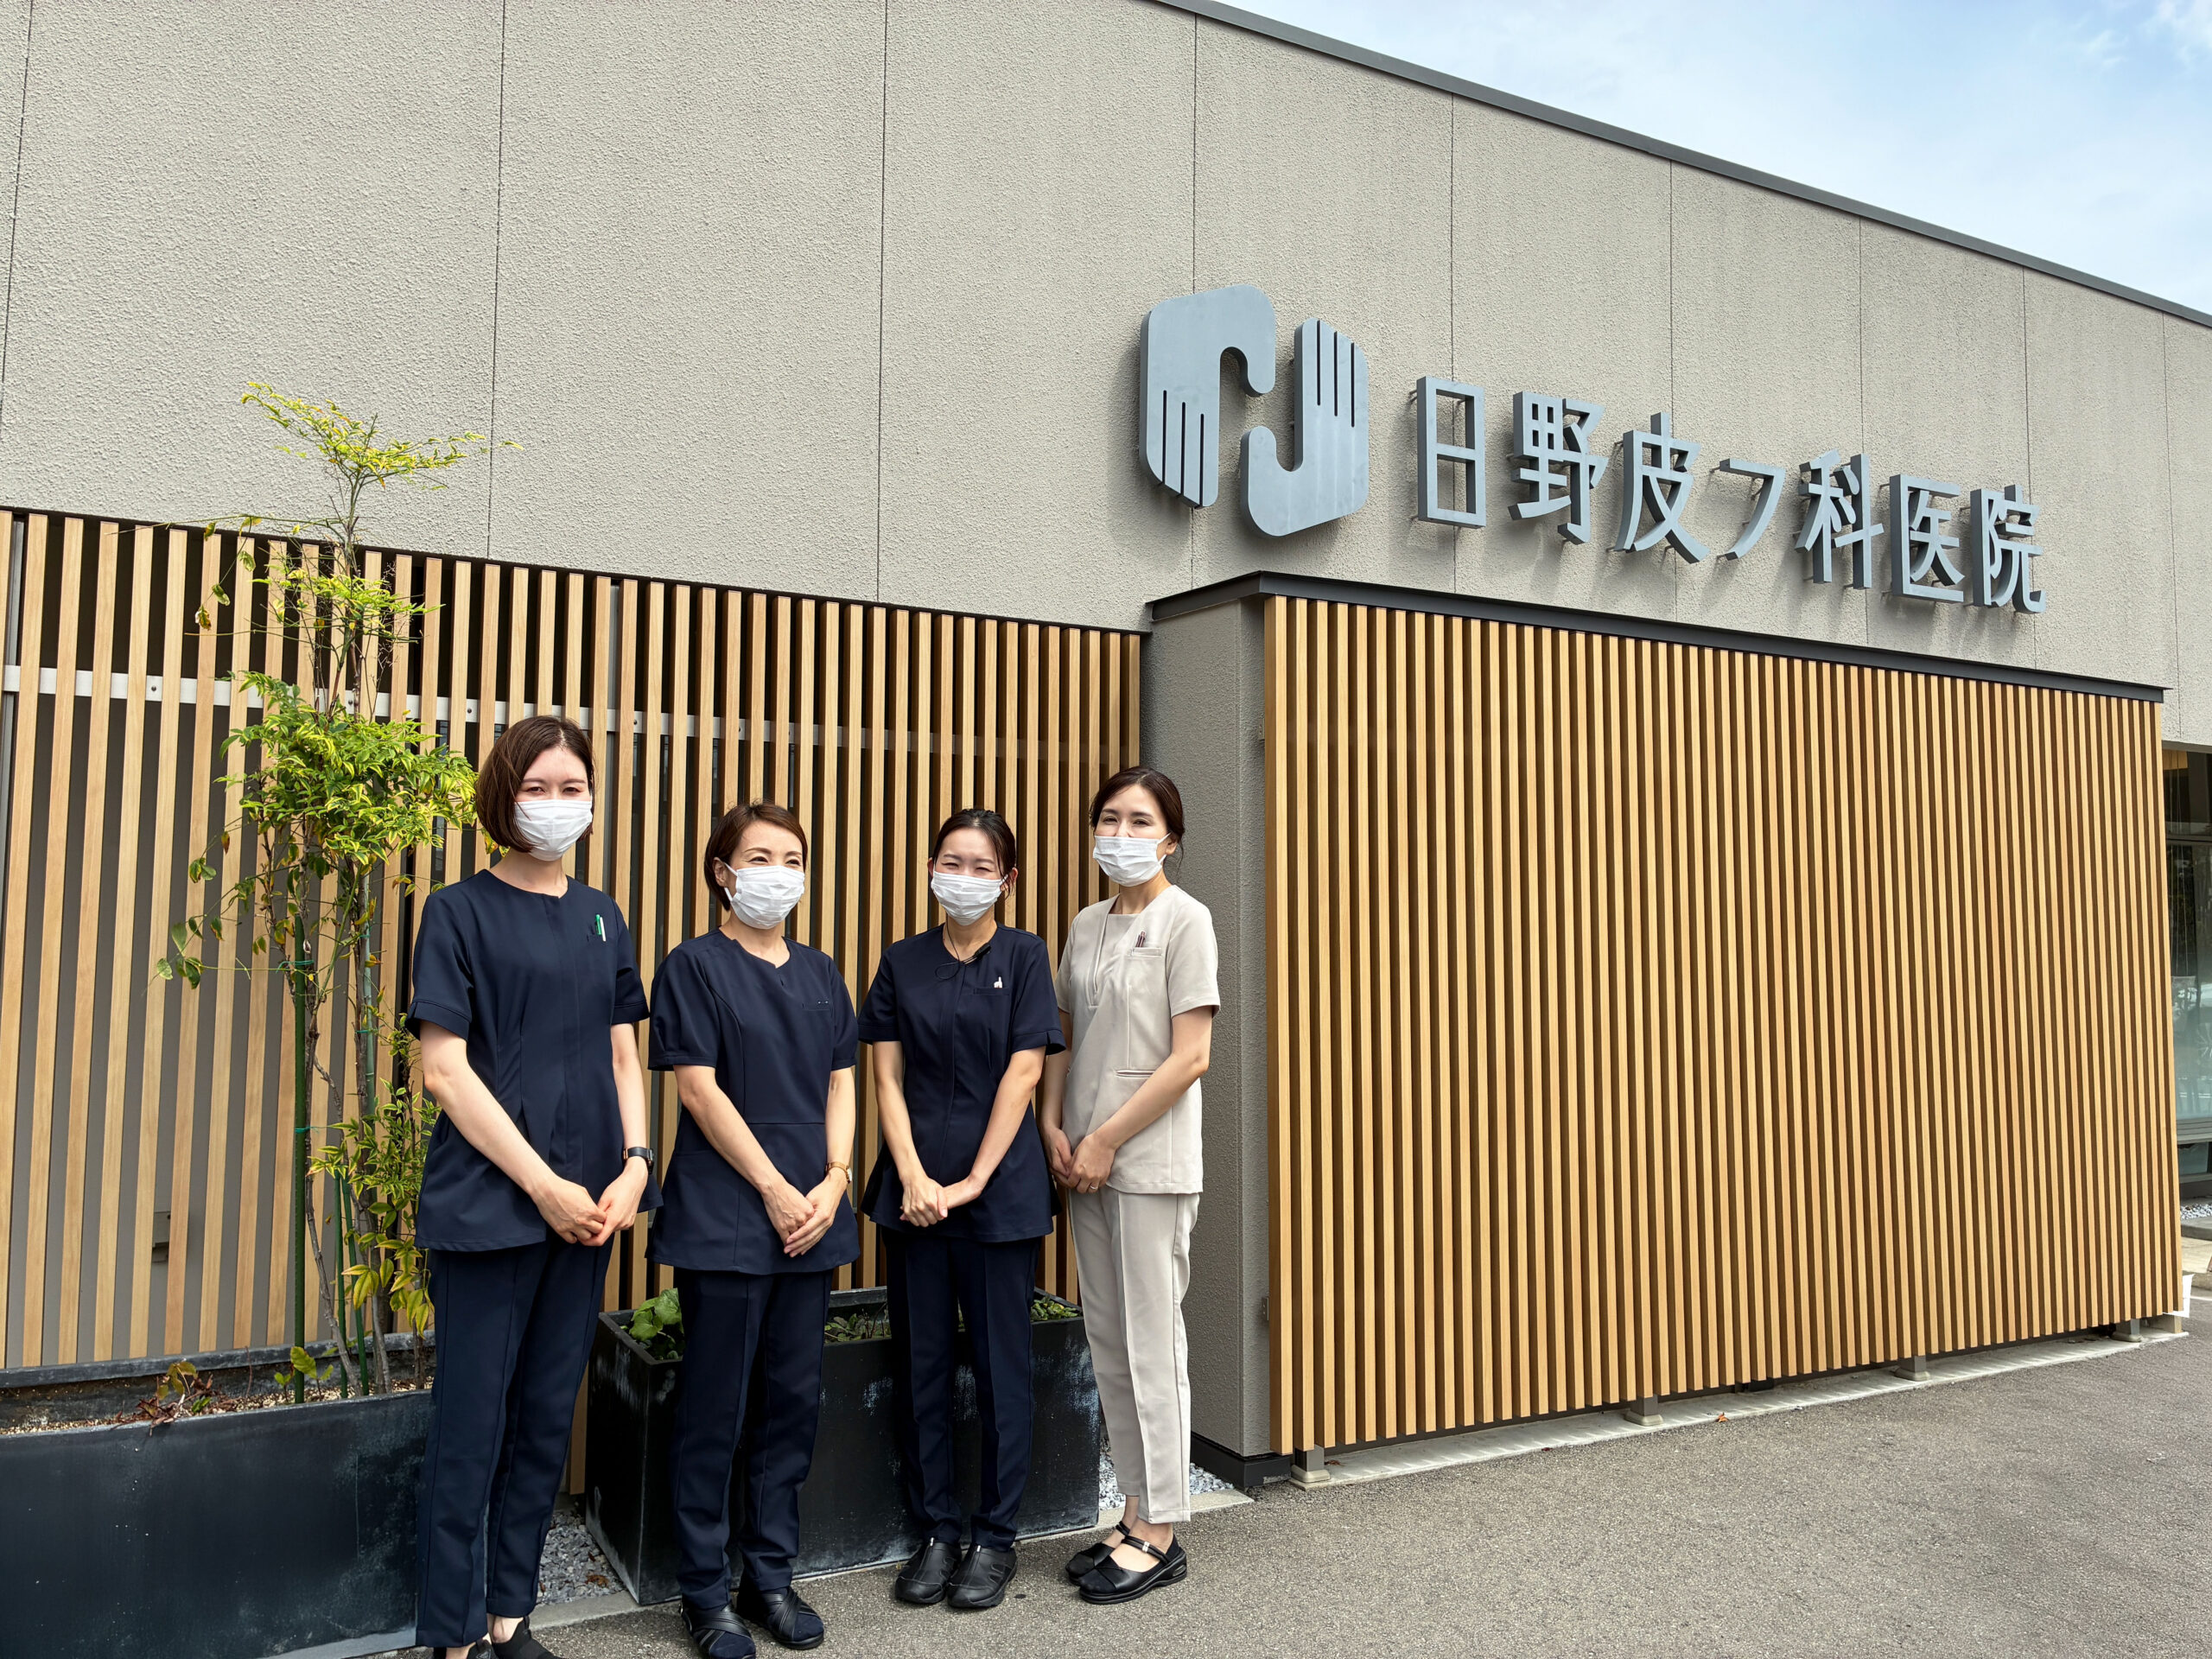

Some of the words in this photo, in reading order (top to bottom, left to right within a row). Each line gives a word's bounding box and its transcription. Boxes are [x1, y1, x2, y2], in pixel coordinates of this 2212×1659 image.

[1416, 375, 2046, 613] 日野皮フ科医院
